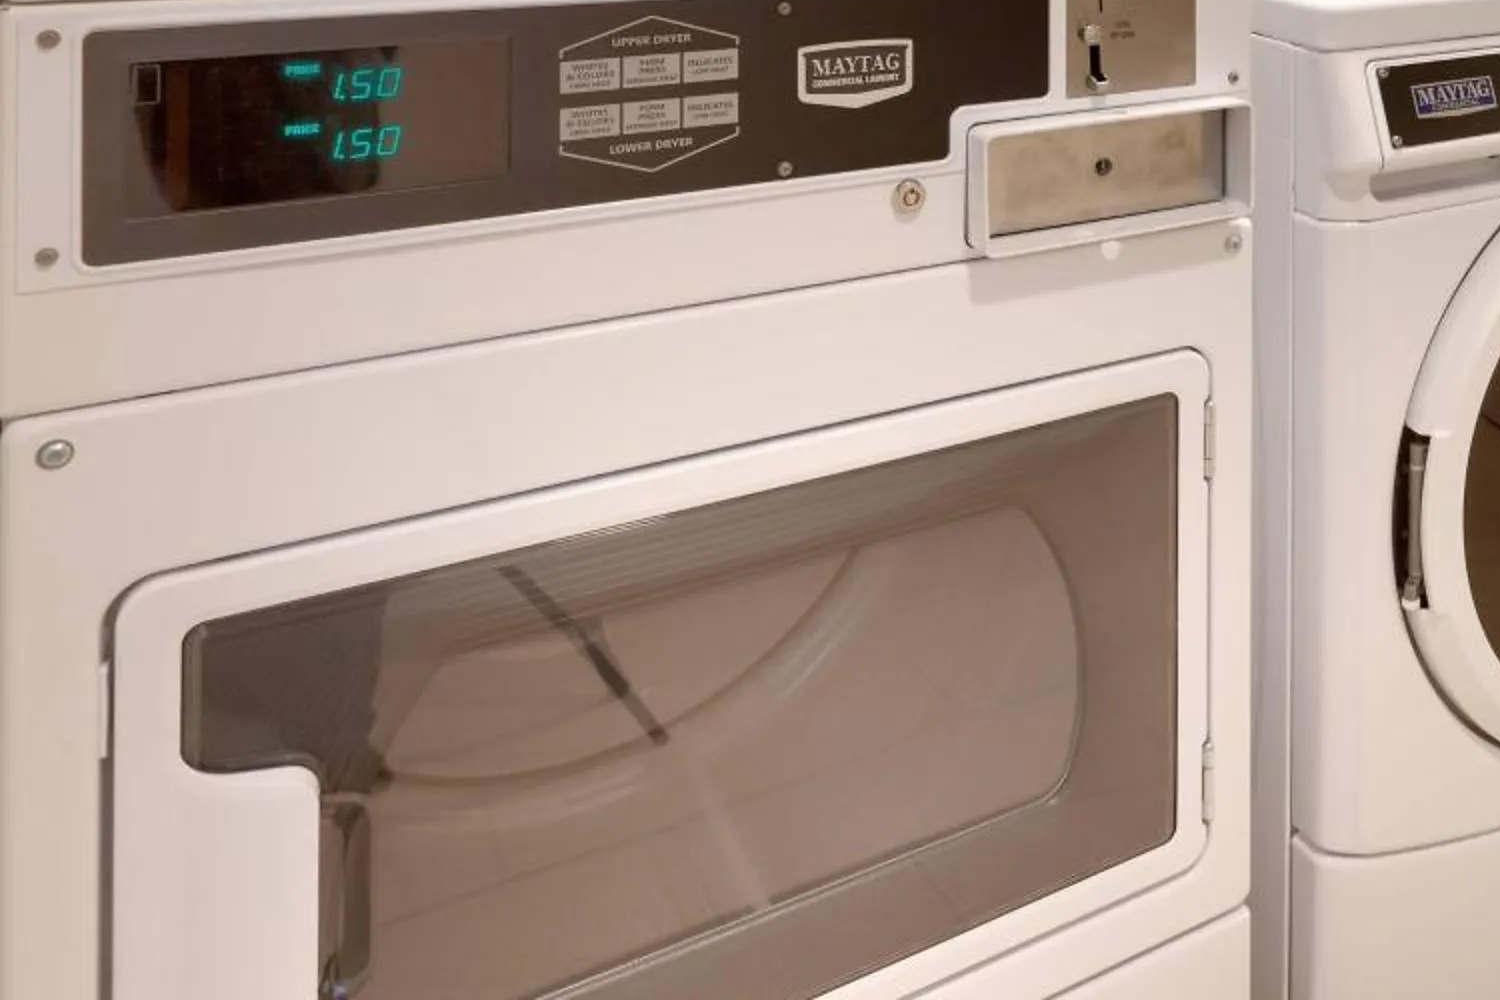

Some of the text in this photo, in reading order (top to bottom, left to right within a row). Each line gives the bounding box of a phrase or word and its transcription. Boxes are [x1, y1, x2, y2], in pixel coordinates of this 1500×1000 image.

[611, 33, 692, 47] UPPER DRYER
[811, 53, 900, 77] MAYTAG
[1416, 79, 1490, 107] MAYTAG
[609, 137, 693, 155] LOWER DRYER
